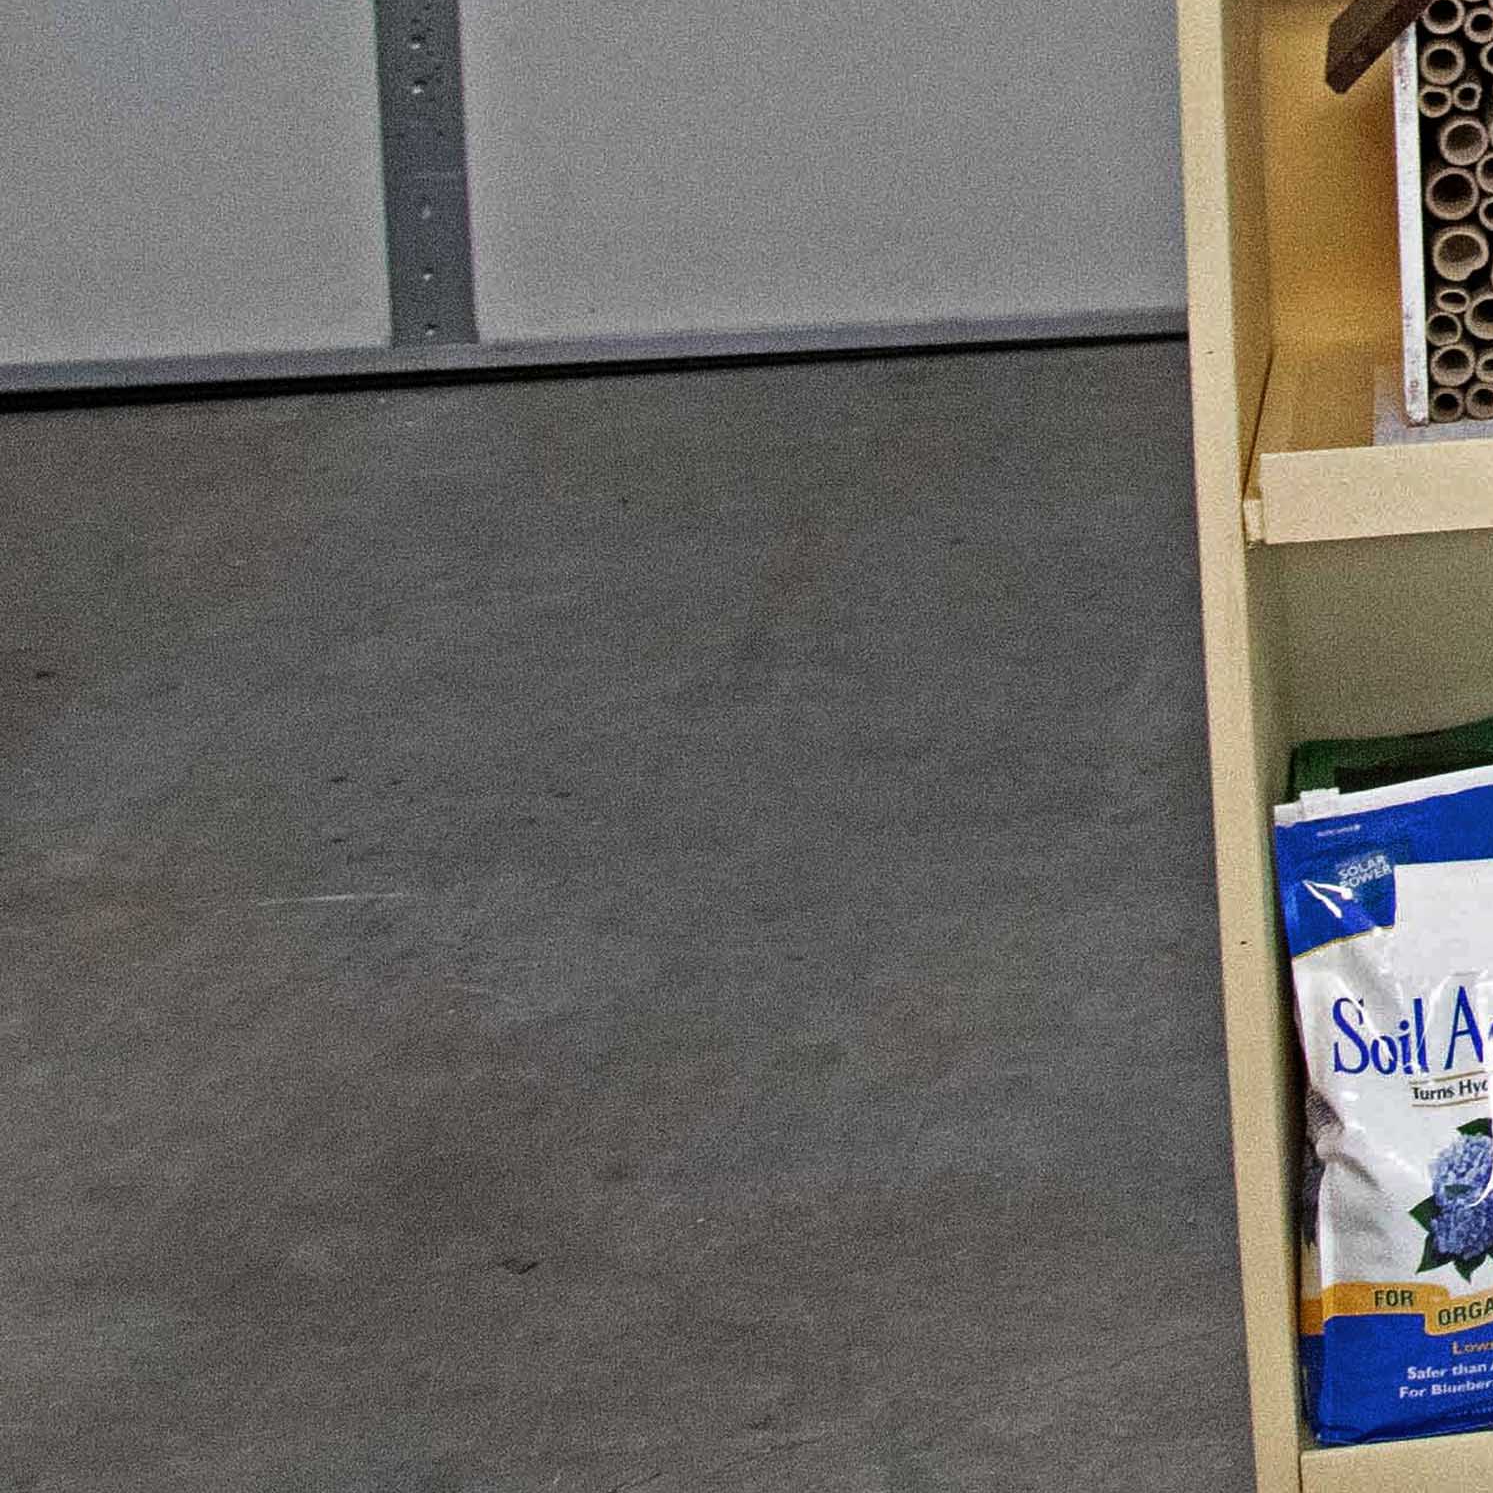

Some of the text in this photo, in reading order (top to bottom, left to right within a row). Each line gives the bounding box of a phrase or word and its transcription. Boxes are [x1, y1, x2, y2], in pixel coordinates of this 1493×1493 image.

[1333, 996, 1430, 1074] Soil
[1412, 1087, 1455, 1099] Turns
[1373, 1290, 1414, 1308] FOR
[1407, 1365, 1447, 1381] Safer
[1452, 1363, 1487, 1376] than
[1399, 1385, 1426, 1399] For
